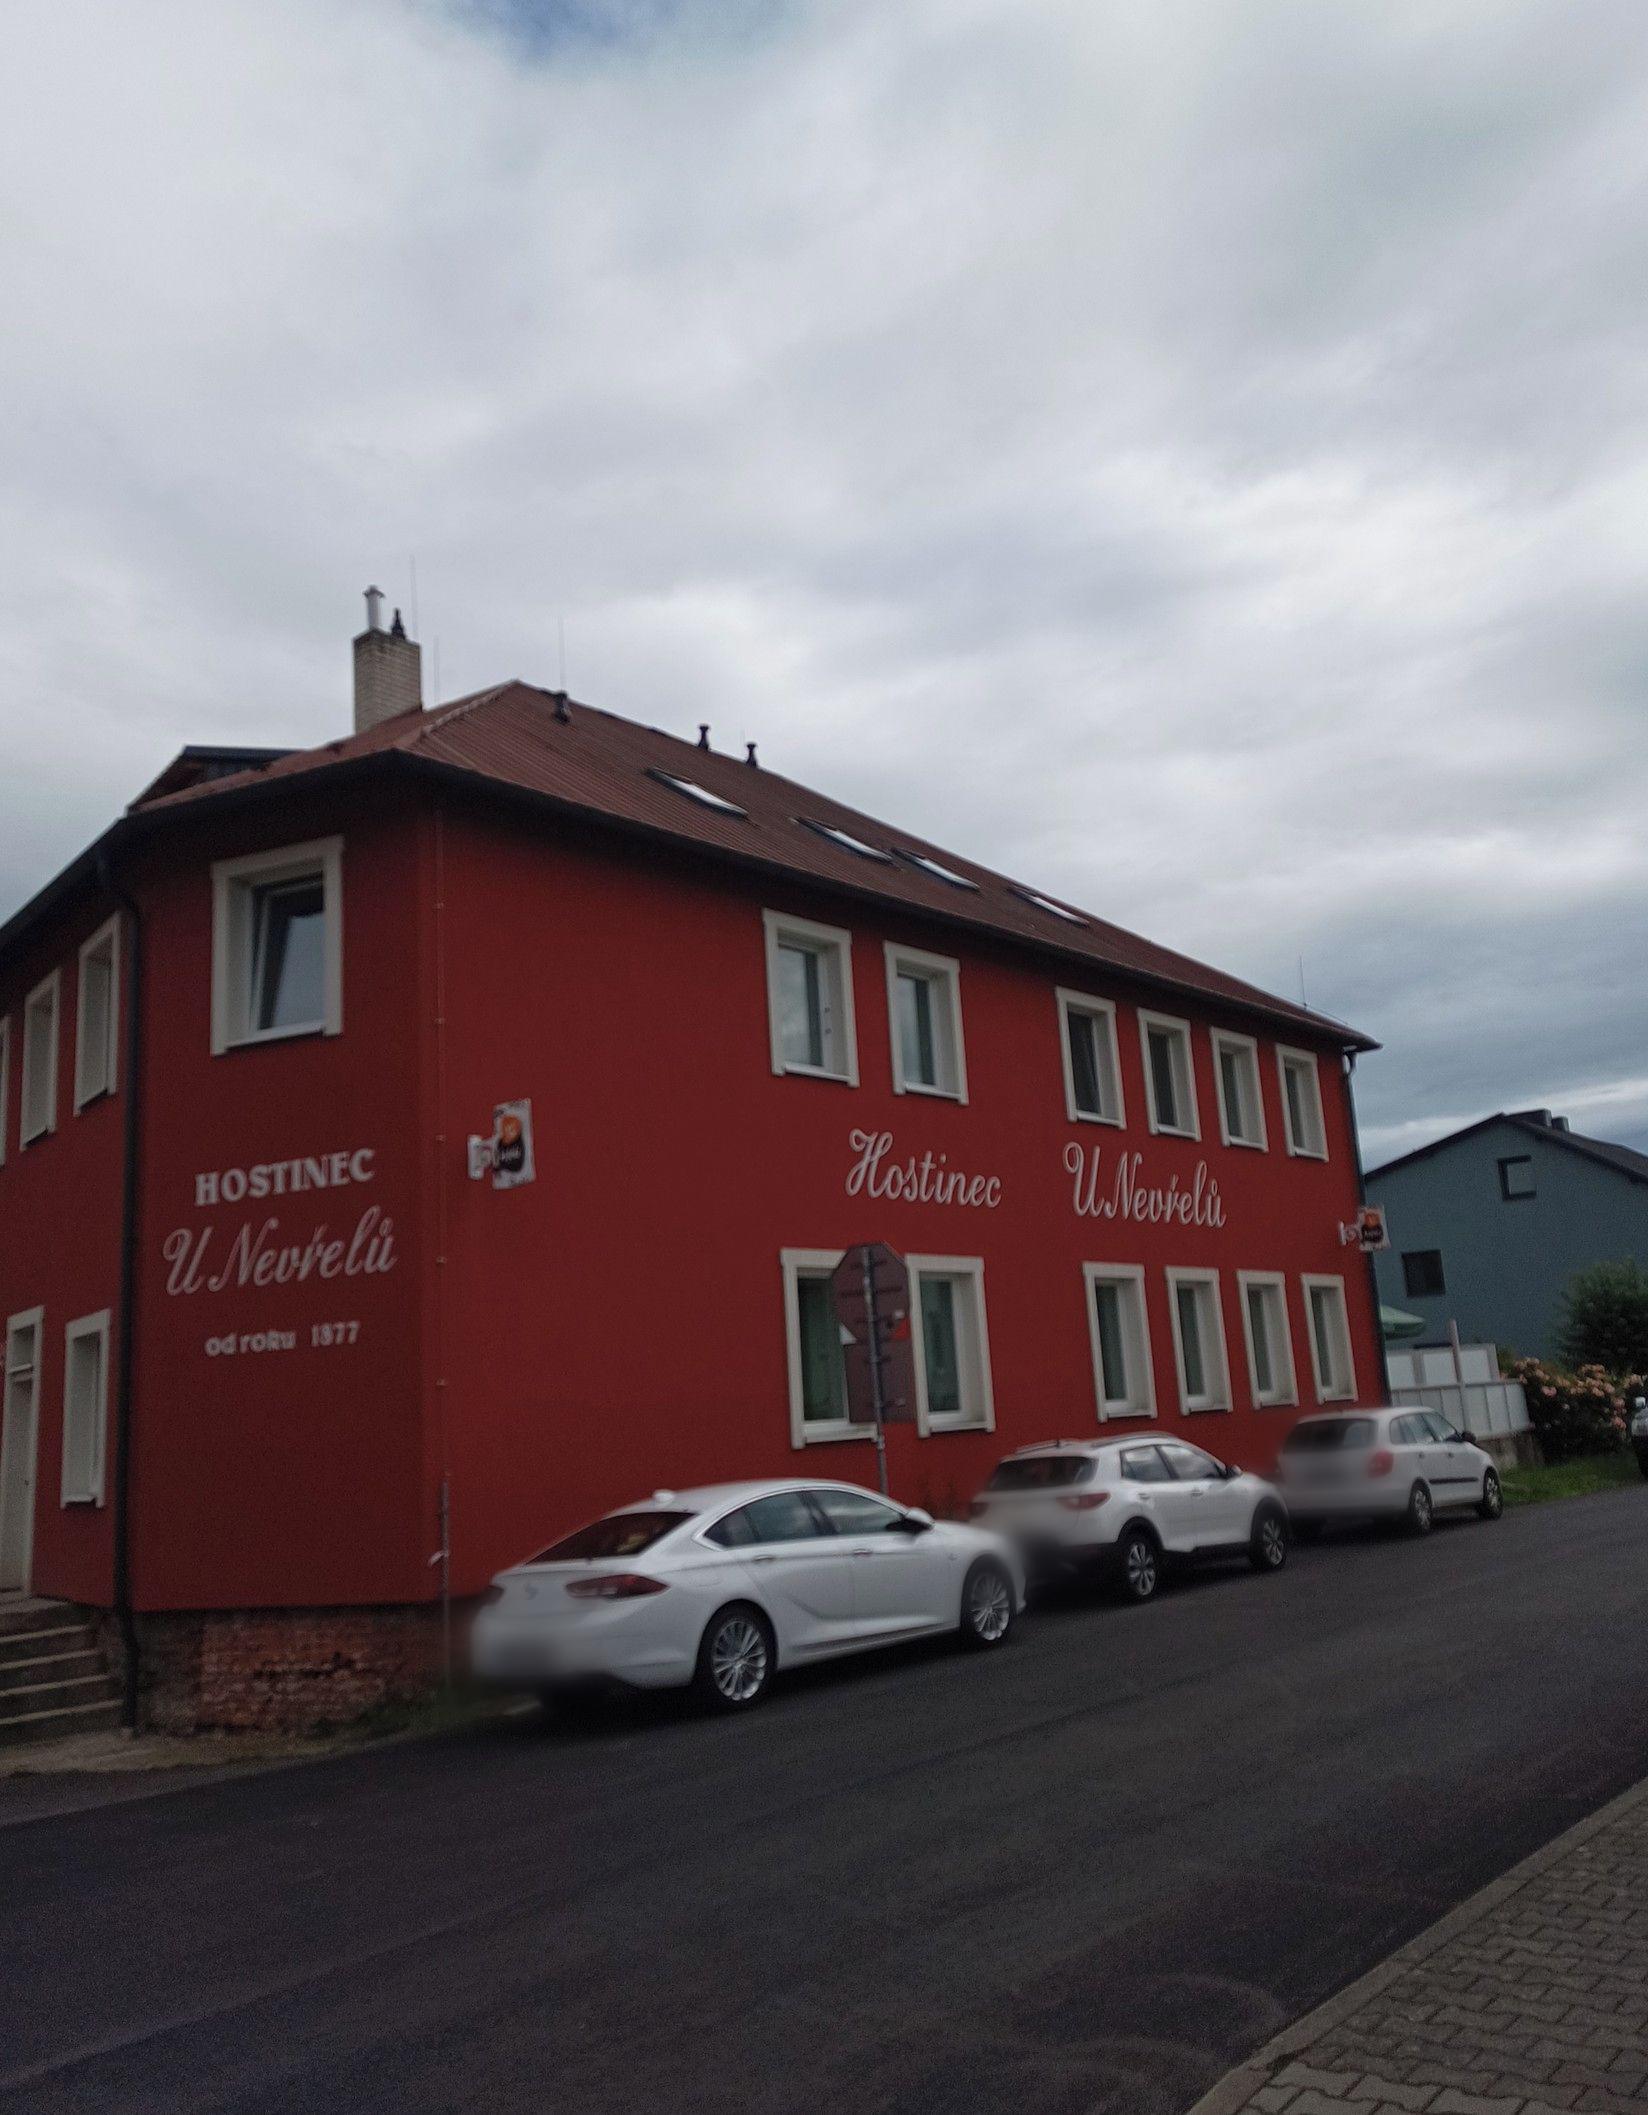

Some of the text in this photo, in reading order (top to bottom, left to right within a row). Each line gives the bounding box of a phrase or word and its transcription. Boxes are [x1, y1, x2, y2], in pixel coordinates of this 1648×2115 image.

[194, 1147, 376, 1207] HOSTINEC
[844, 1128, 1003, 1209] Hostinec
[1062, 1141, 1107, 1218] U
[162, 1225, 214, 1297] U
[203, 1331, 237, 1358] od
[310, 1320, 361, 1347] 1877
